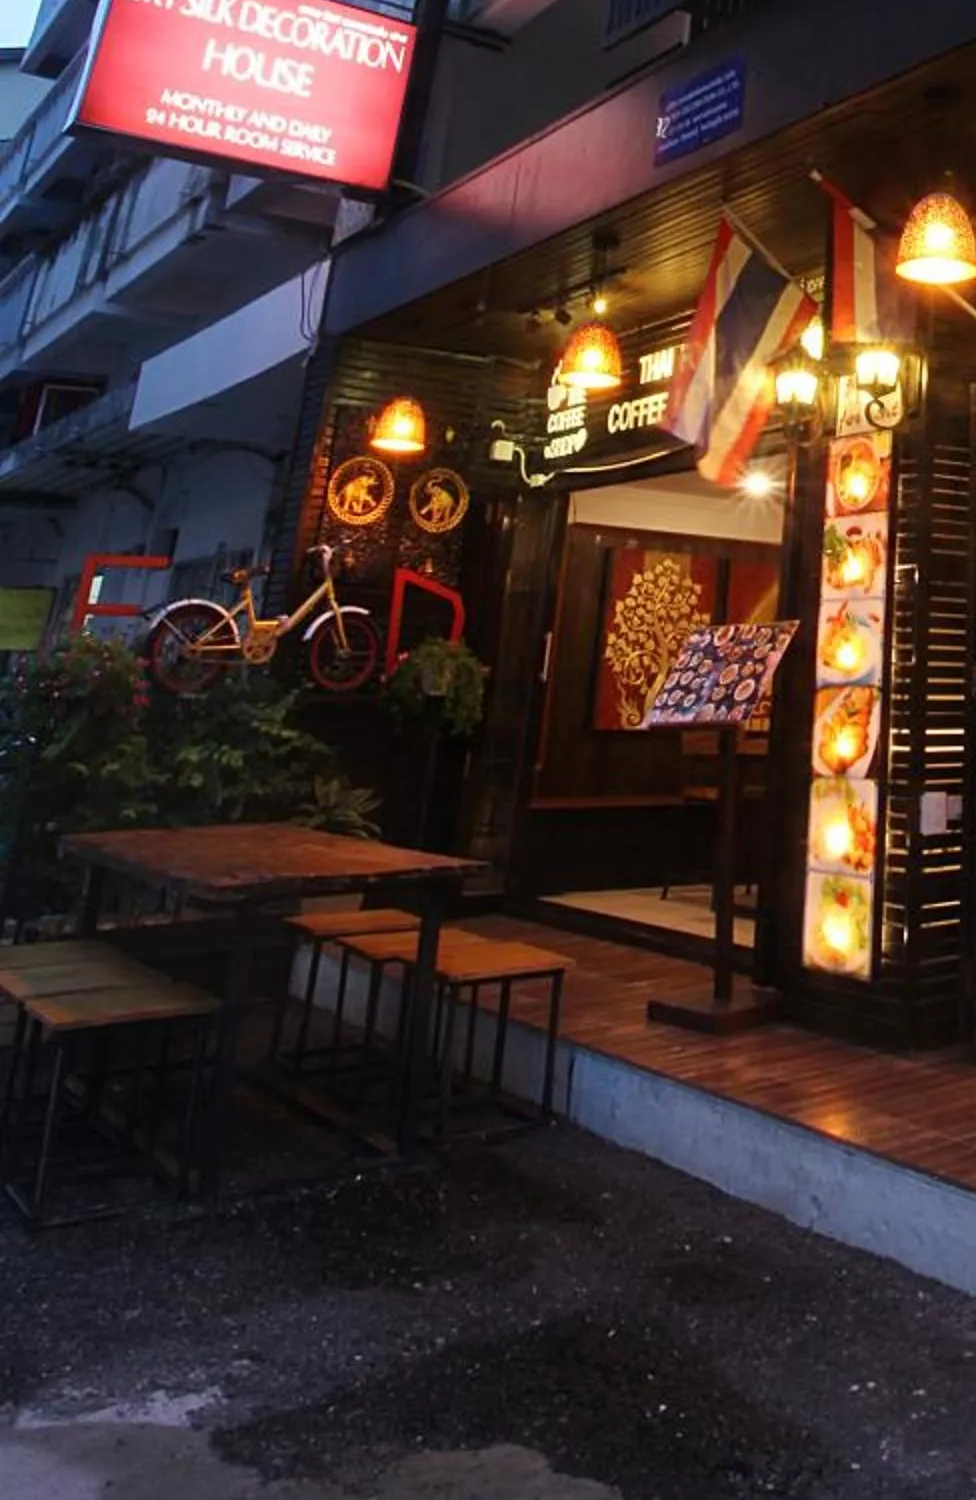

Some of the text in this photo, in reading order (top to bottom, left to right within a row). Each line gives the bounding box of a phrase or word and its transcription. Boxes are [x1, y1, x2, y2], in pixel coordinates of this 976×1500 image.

[238, 0, 406, 75] DECORATION
[202, 37, 316, 98] HOUSE
[168, 110, 223, 140] HOUR
[223, 124, 280, 153] ROOM
[246, 109, 287, 134] AND
